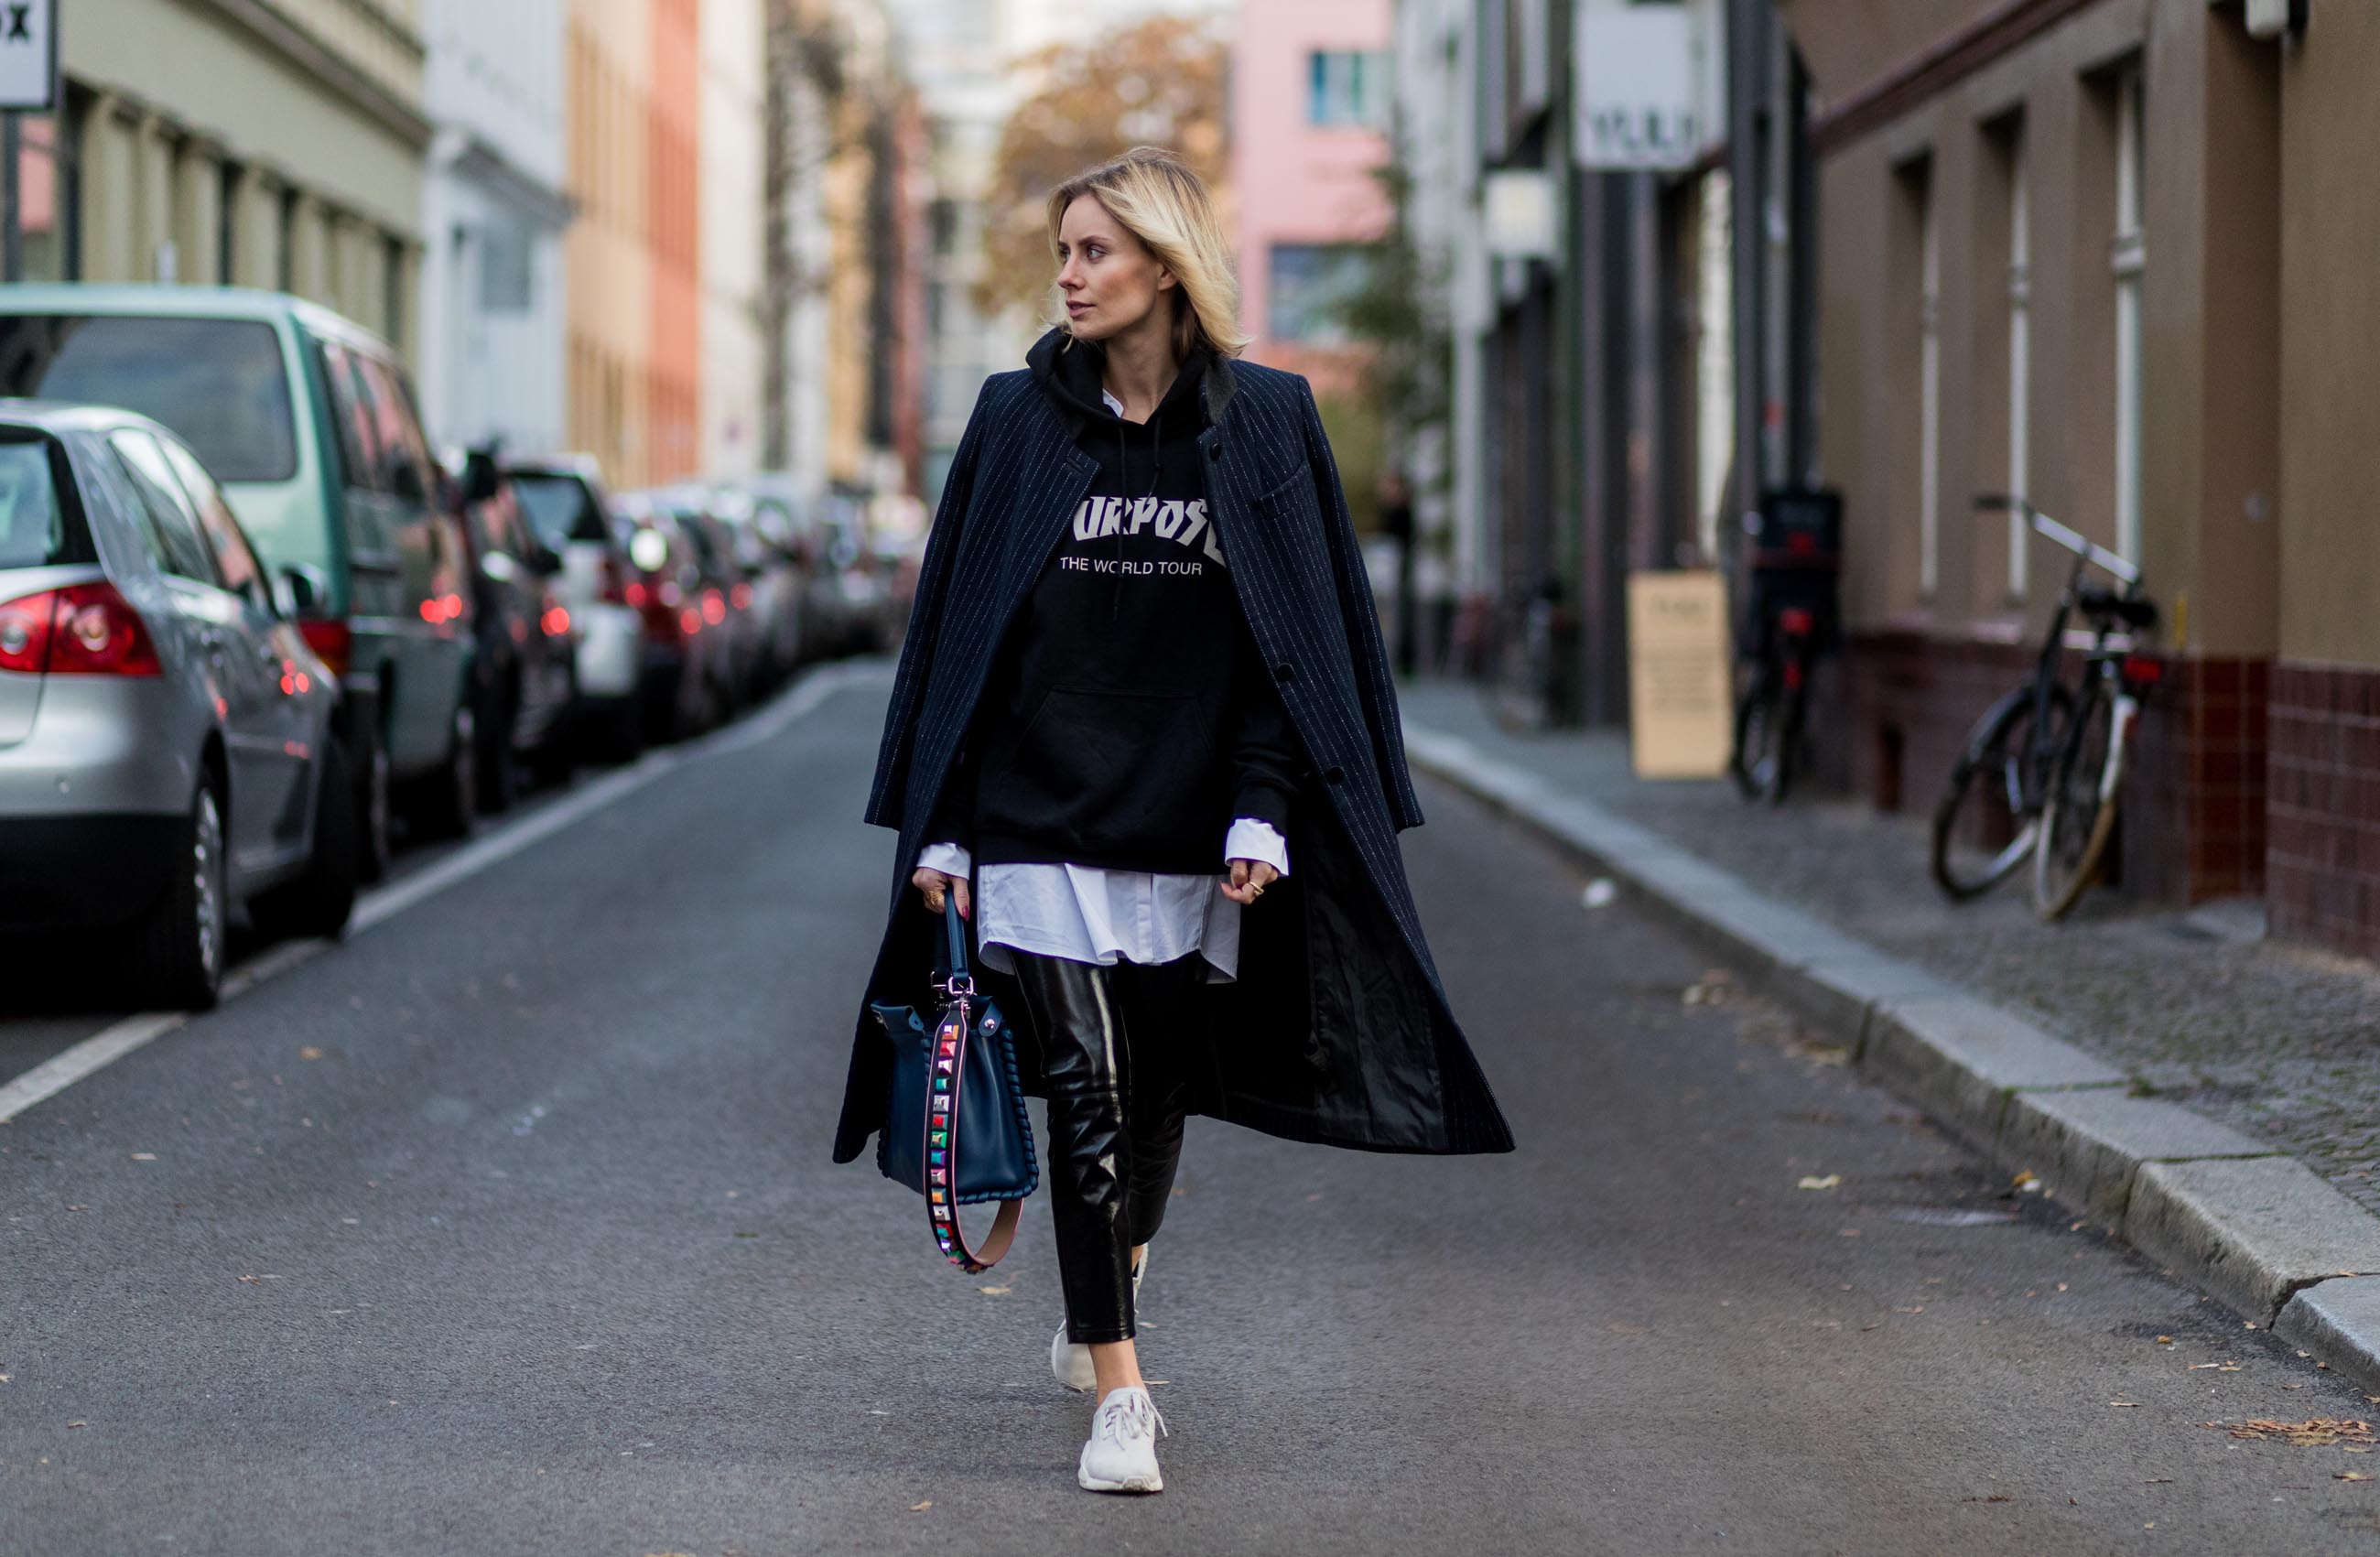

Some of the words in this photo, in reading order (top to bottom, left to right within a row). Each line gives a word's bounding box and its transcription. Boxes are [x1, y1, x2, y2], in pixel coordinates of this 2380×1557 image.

[1060, 557, 1089, 571] THE
[1094, 559, 1153, 575] WORLD
[1158, 561, 1202, 576] TOUR
